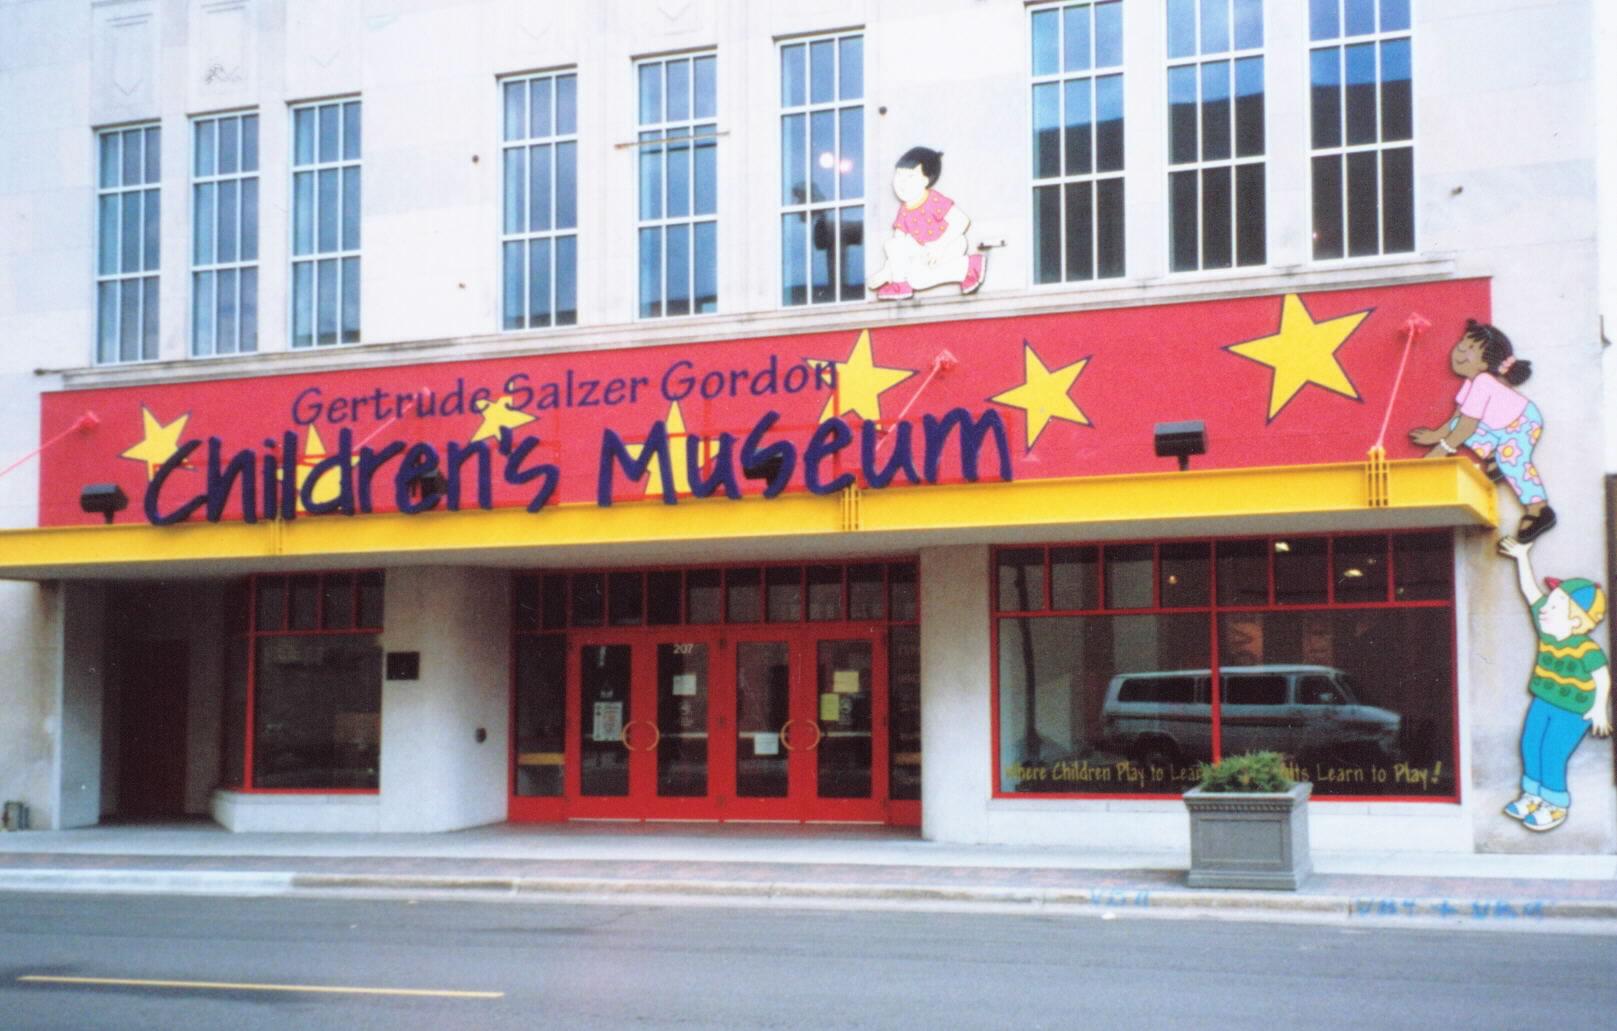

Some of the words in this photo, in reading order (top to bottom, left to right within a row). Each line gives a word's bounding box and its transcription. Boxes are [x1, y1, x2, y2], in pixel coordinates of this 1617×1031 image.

[291, 377, 491, 426] Gertrude
[503, 369, 648, 411] Salzer
[660, 354, 836, 401] Gordon
[144, 426, 560, 526] Children's
[597, 407, 1013, 507] Museum
[673, 643, 694, 654] 207
[1052, 760, 1111, 781] Children
[1116, 761, 1145, 788] Play
[1151, 766, 1164, 780] to
[1316, 763, 1364, 783] Learn
[1372, 765, 1387, 783] to
